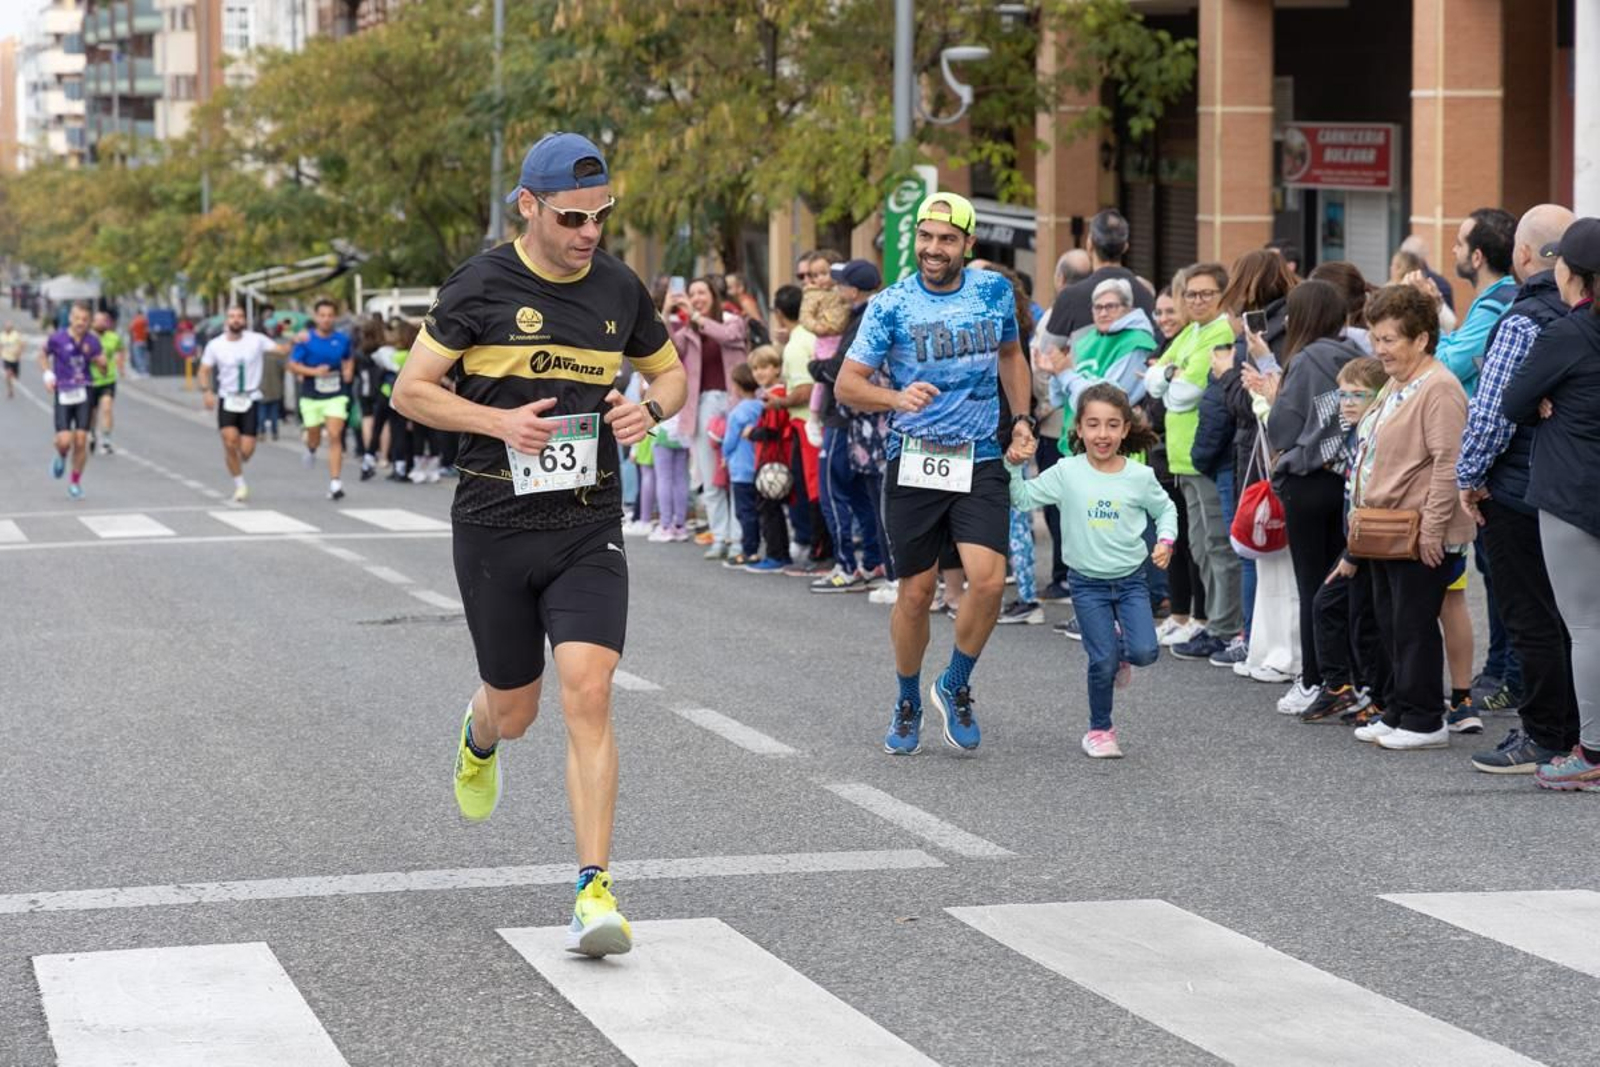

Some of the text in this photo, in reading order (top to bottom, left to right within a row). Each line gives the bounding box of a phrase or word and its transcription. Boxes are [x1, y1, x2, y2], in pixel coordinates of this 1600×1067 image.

[551, 356, 605, 376] Avanza
[539, 443, 576, 473] 63
[922, 456, 950, 478] 66
